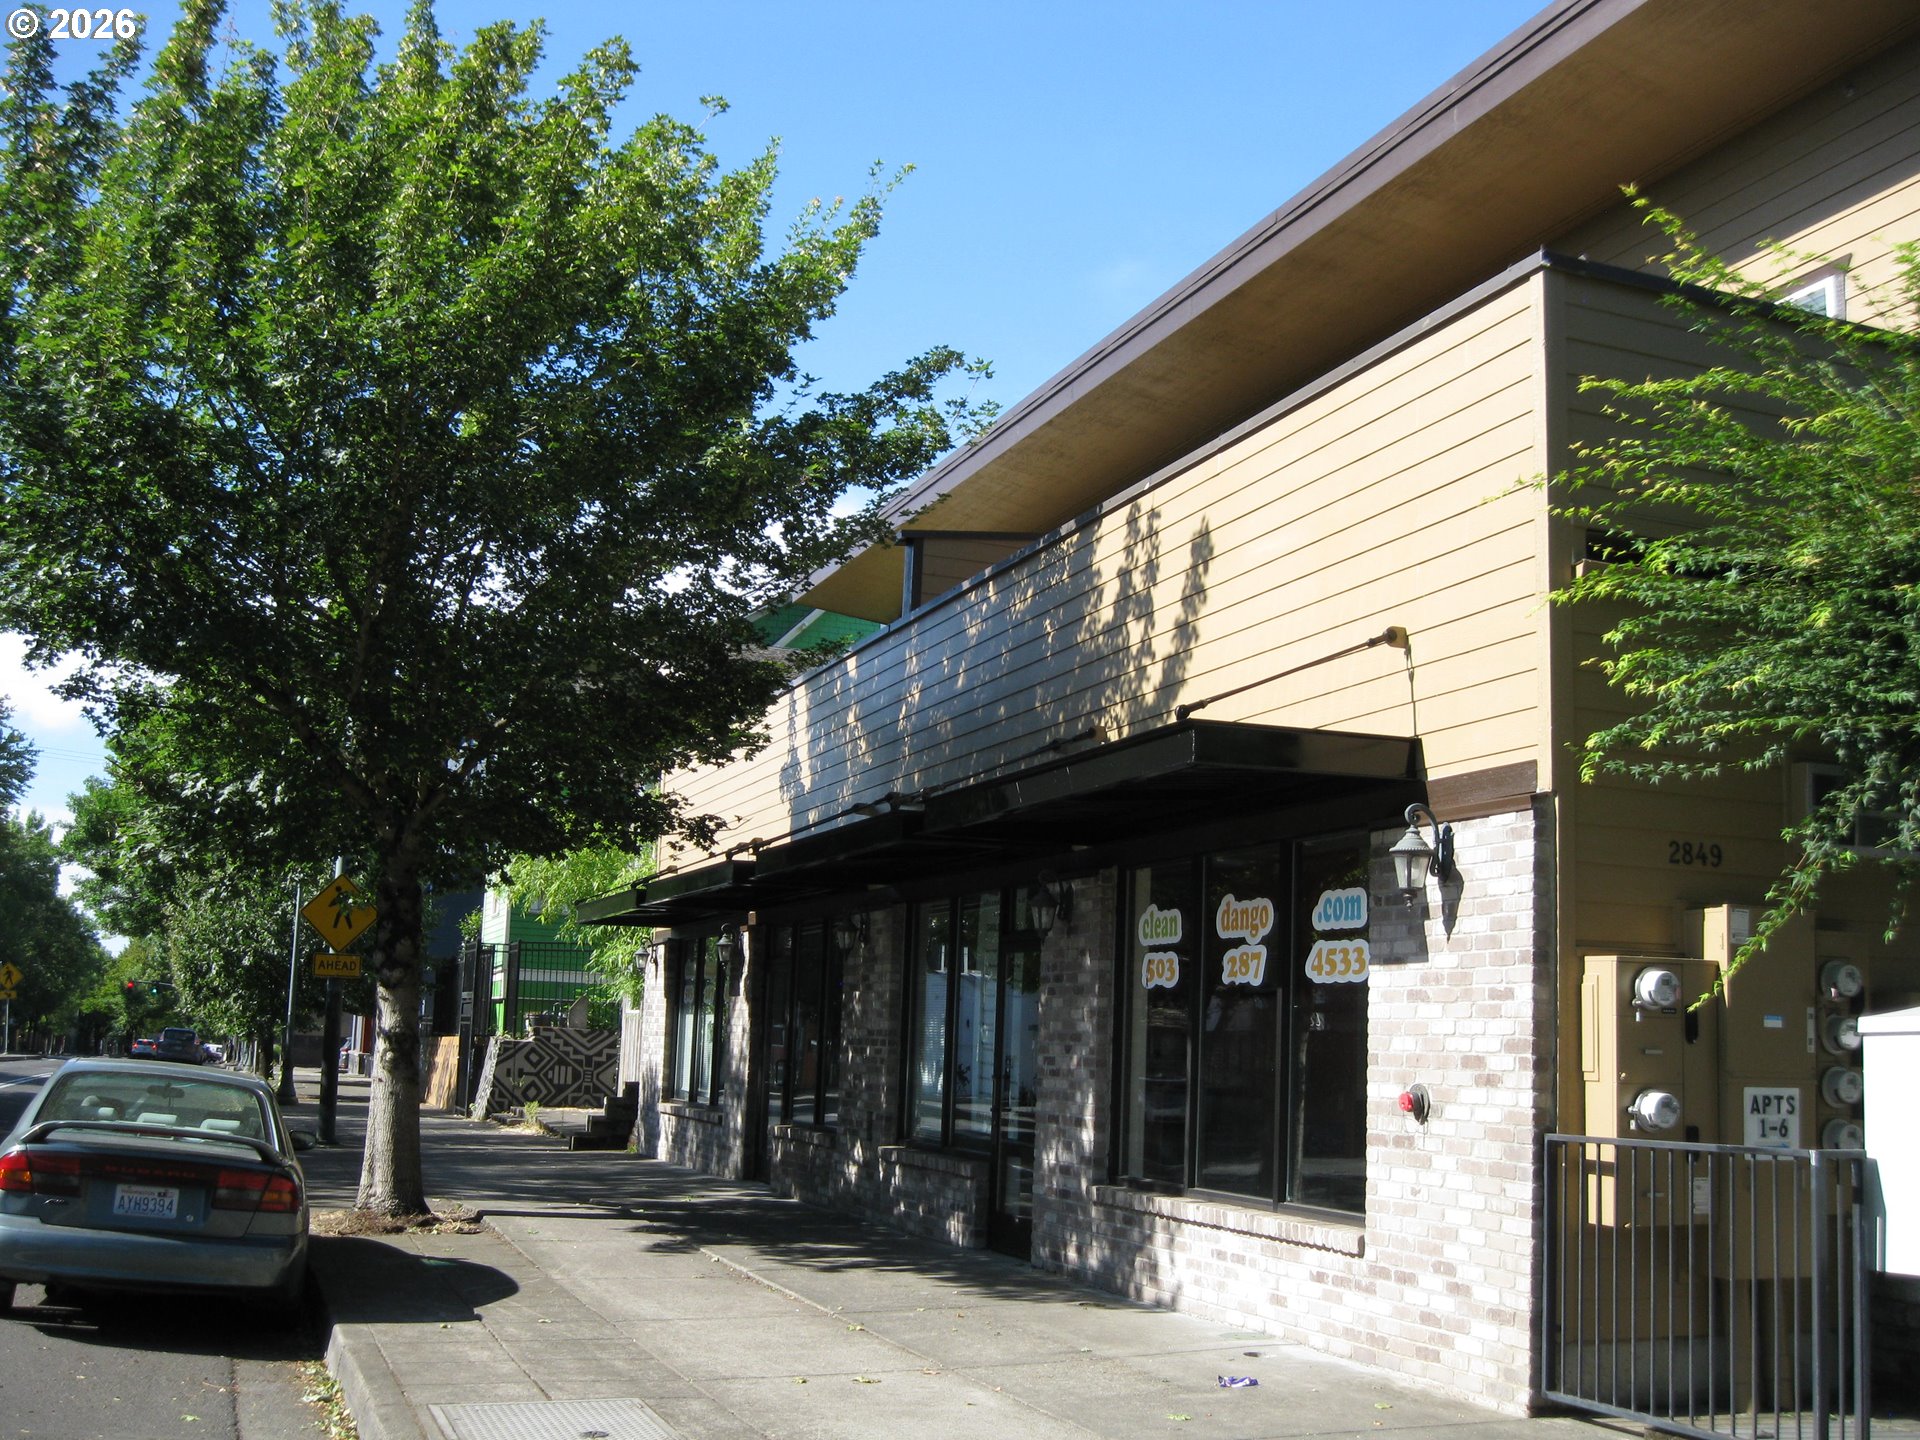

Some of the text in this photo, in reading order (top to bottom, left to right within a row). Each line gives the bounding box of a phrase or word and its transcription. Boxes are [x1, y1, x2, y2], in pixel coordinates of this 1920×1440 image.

[1668, 840, 1723, 867] 2849
[1142, 893, 1362, 940] clean dango .com
[318, 960, 357, 971] AHEAD
[1146, 946, 1367, 983] 503 287 4533
[1750, 1094, 1796, 1115] APTS
[1759, 1117, 1788, 1138] 1-6
[117, 1195, 175, 1214] AYH9394
